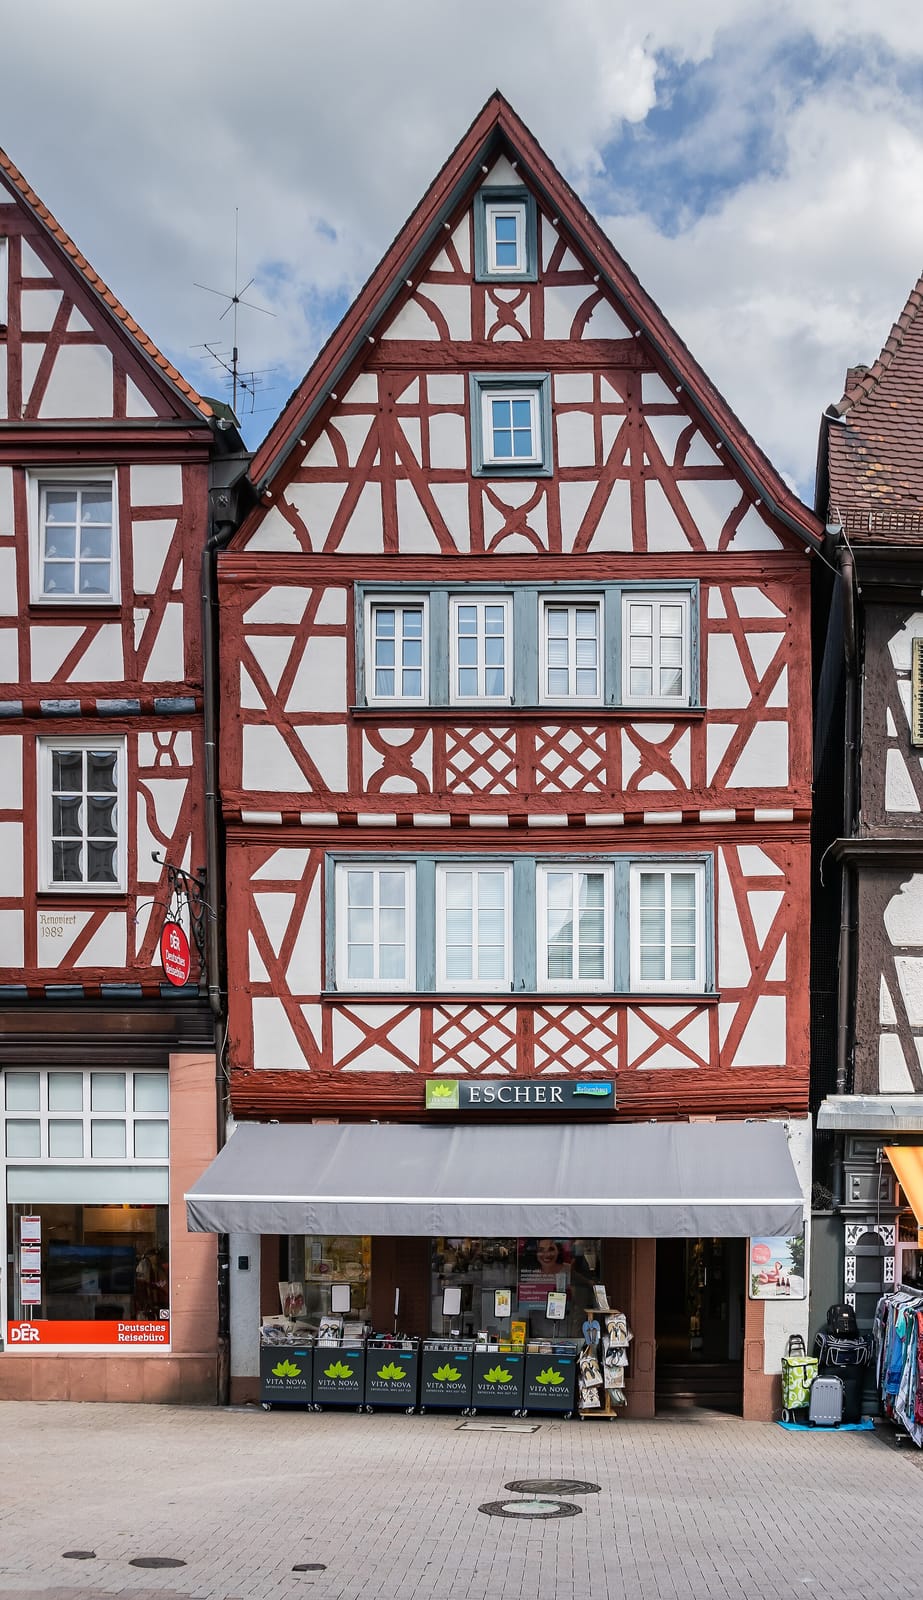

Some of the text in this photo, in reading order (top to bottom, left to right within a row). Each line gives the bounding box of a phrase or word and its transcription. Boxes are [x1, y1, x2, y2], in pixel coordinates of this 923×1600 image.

[39, 914, 76, 925] Renoviert
[41, 926, 64, 938] 1982
[468, 1086, 564, 1103] ESCHER
[11, 1325, 40, 1342] DER
[118, 1323, 166, 1333] Deutsches
[118, 1333, 165, 1342] Reisebüro
[286, 1378, 307, 1386] NOVA
